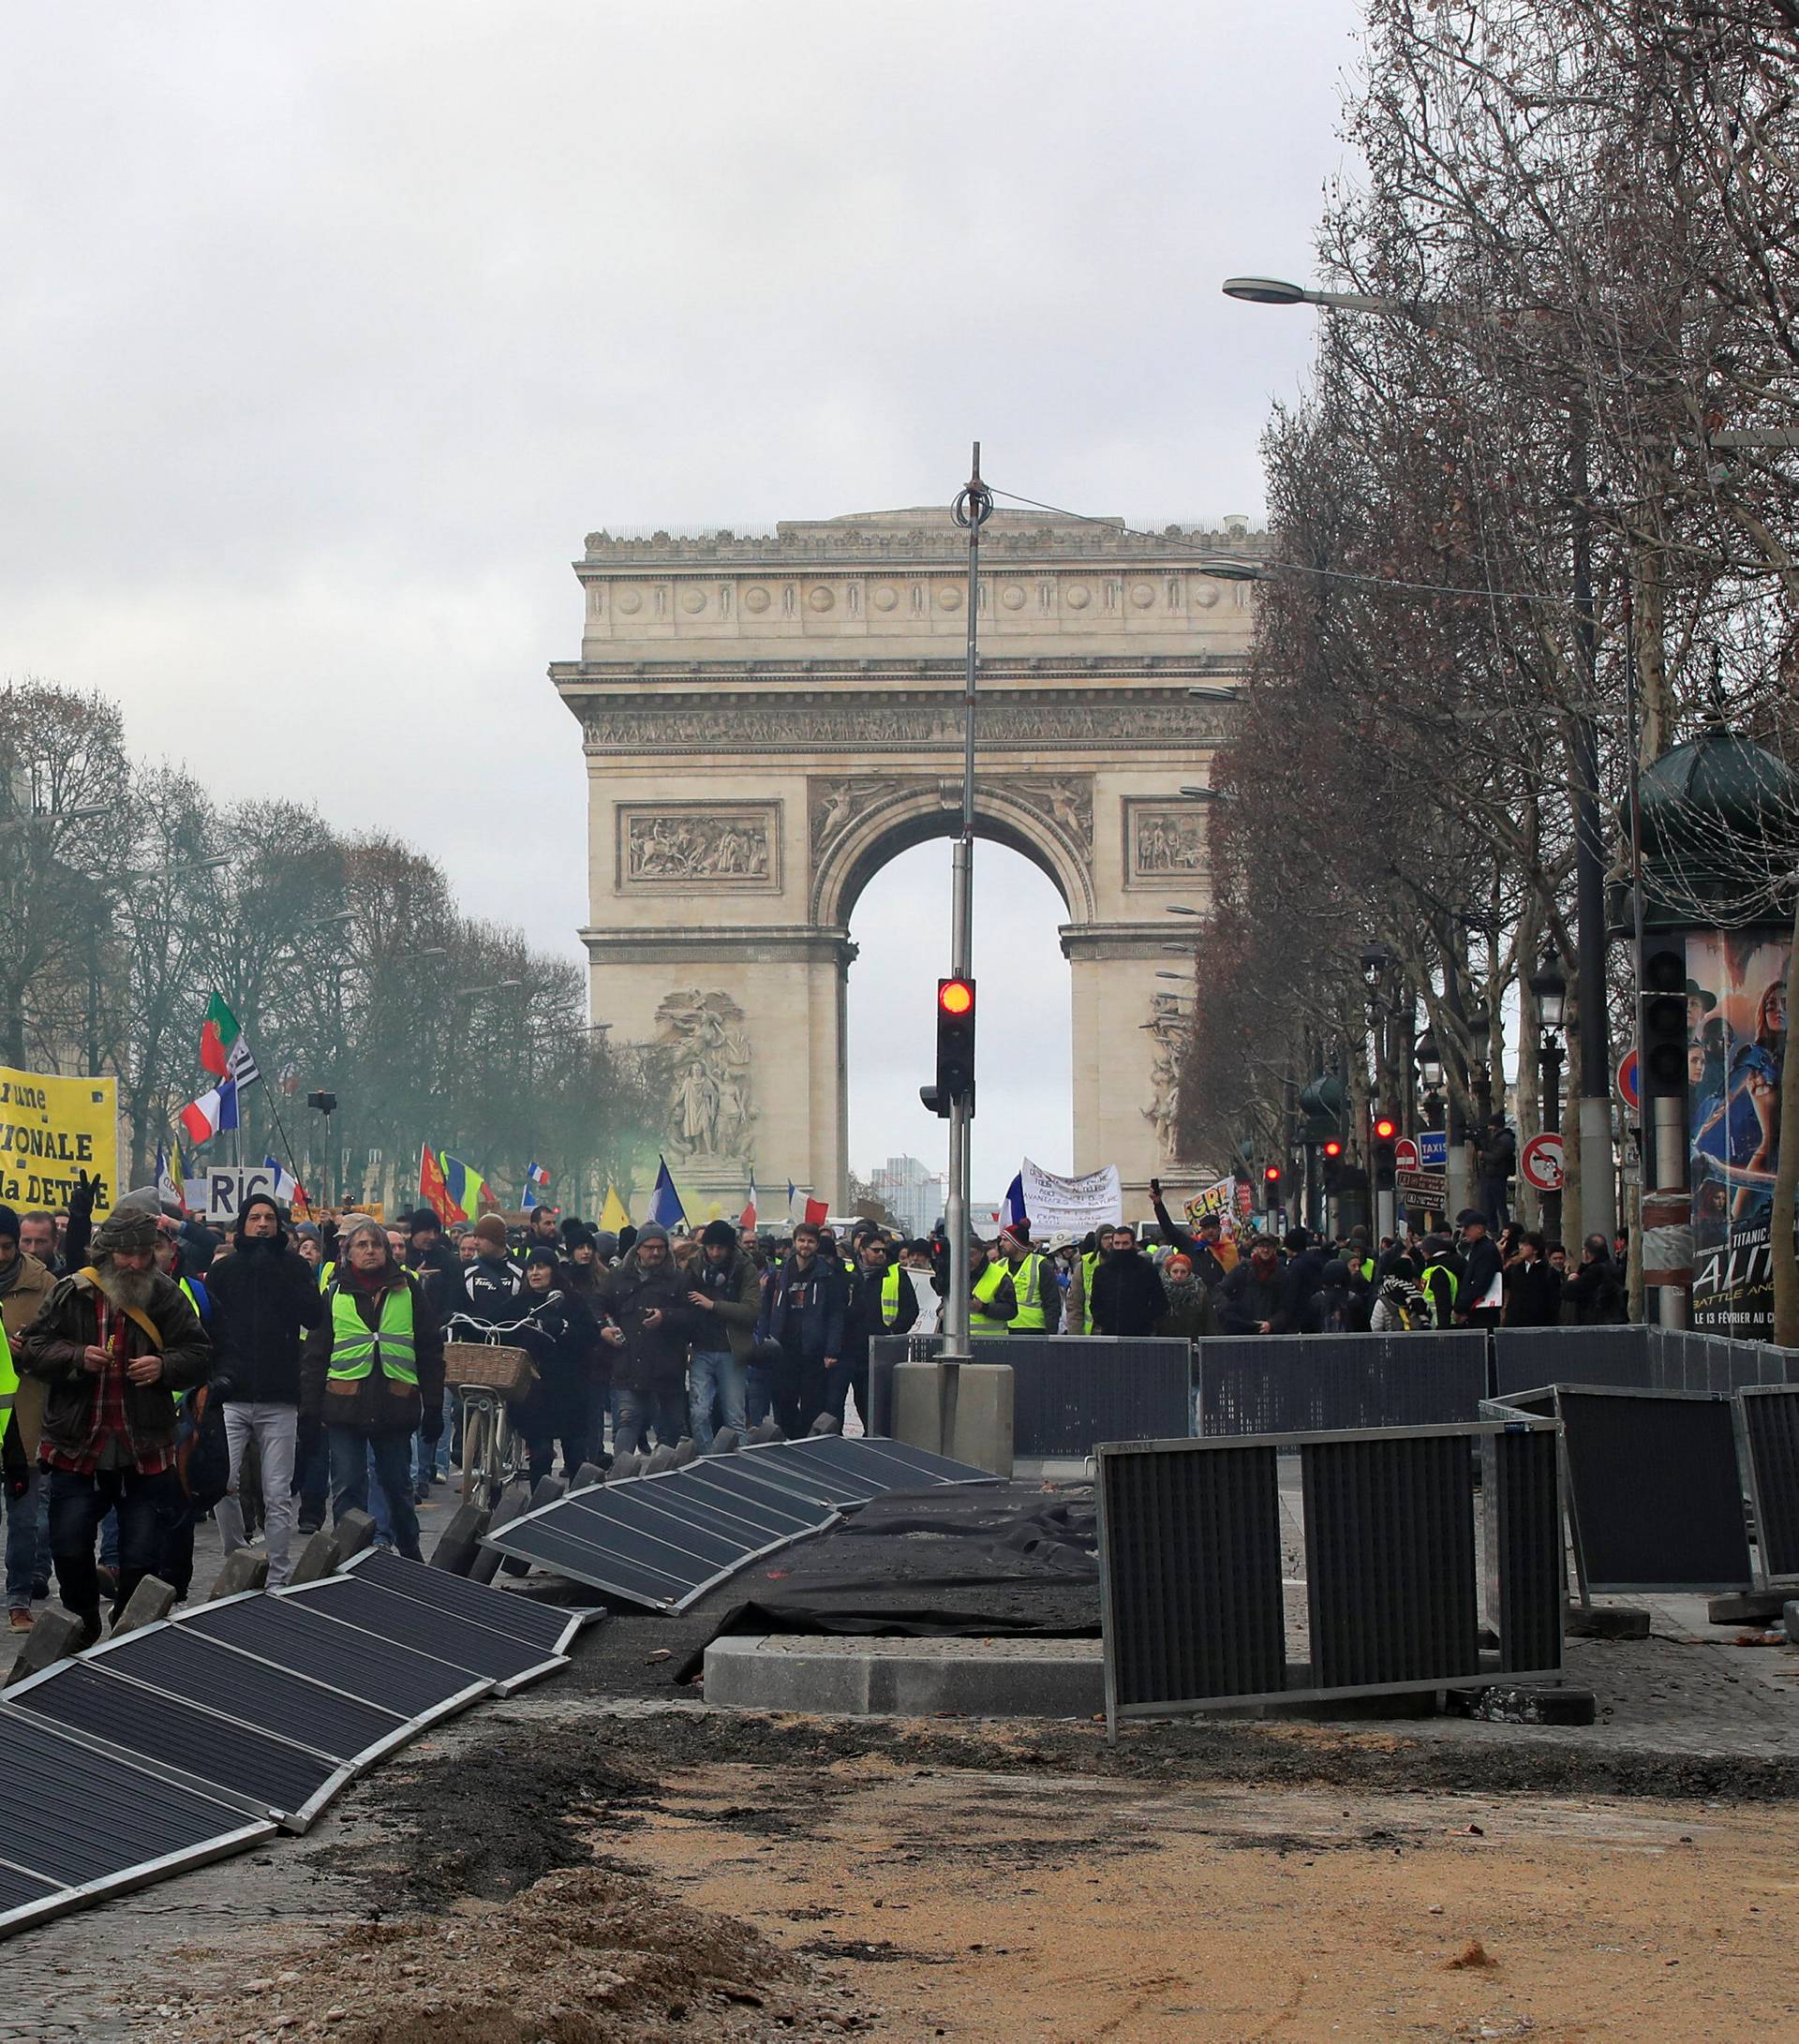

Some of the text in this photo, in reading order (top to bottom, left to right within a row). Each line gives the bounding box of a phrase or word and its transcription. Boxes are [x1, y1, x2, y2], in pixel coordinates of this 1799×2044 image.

[14, 1085, 46, 1110] une
[0, 1123, 93, 1162] IONALE
[26, 1175, 110, 1210] DETE
[1732, 1227, 1766, 1249] TITANIC
[1695, 1313, 1703, 1325] LE
[1706, 1313, 1716, 1324] 13
[1717, 1311, 1750, 1324] FÉVRIER
[1753, 1312, 1764, 1324] AU
